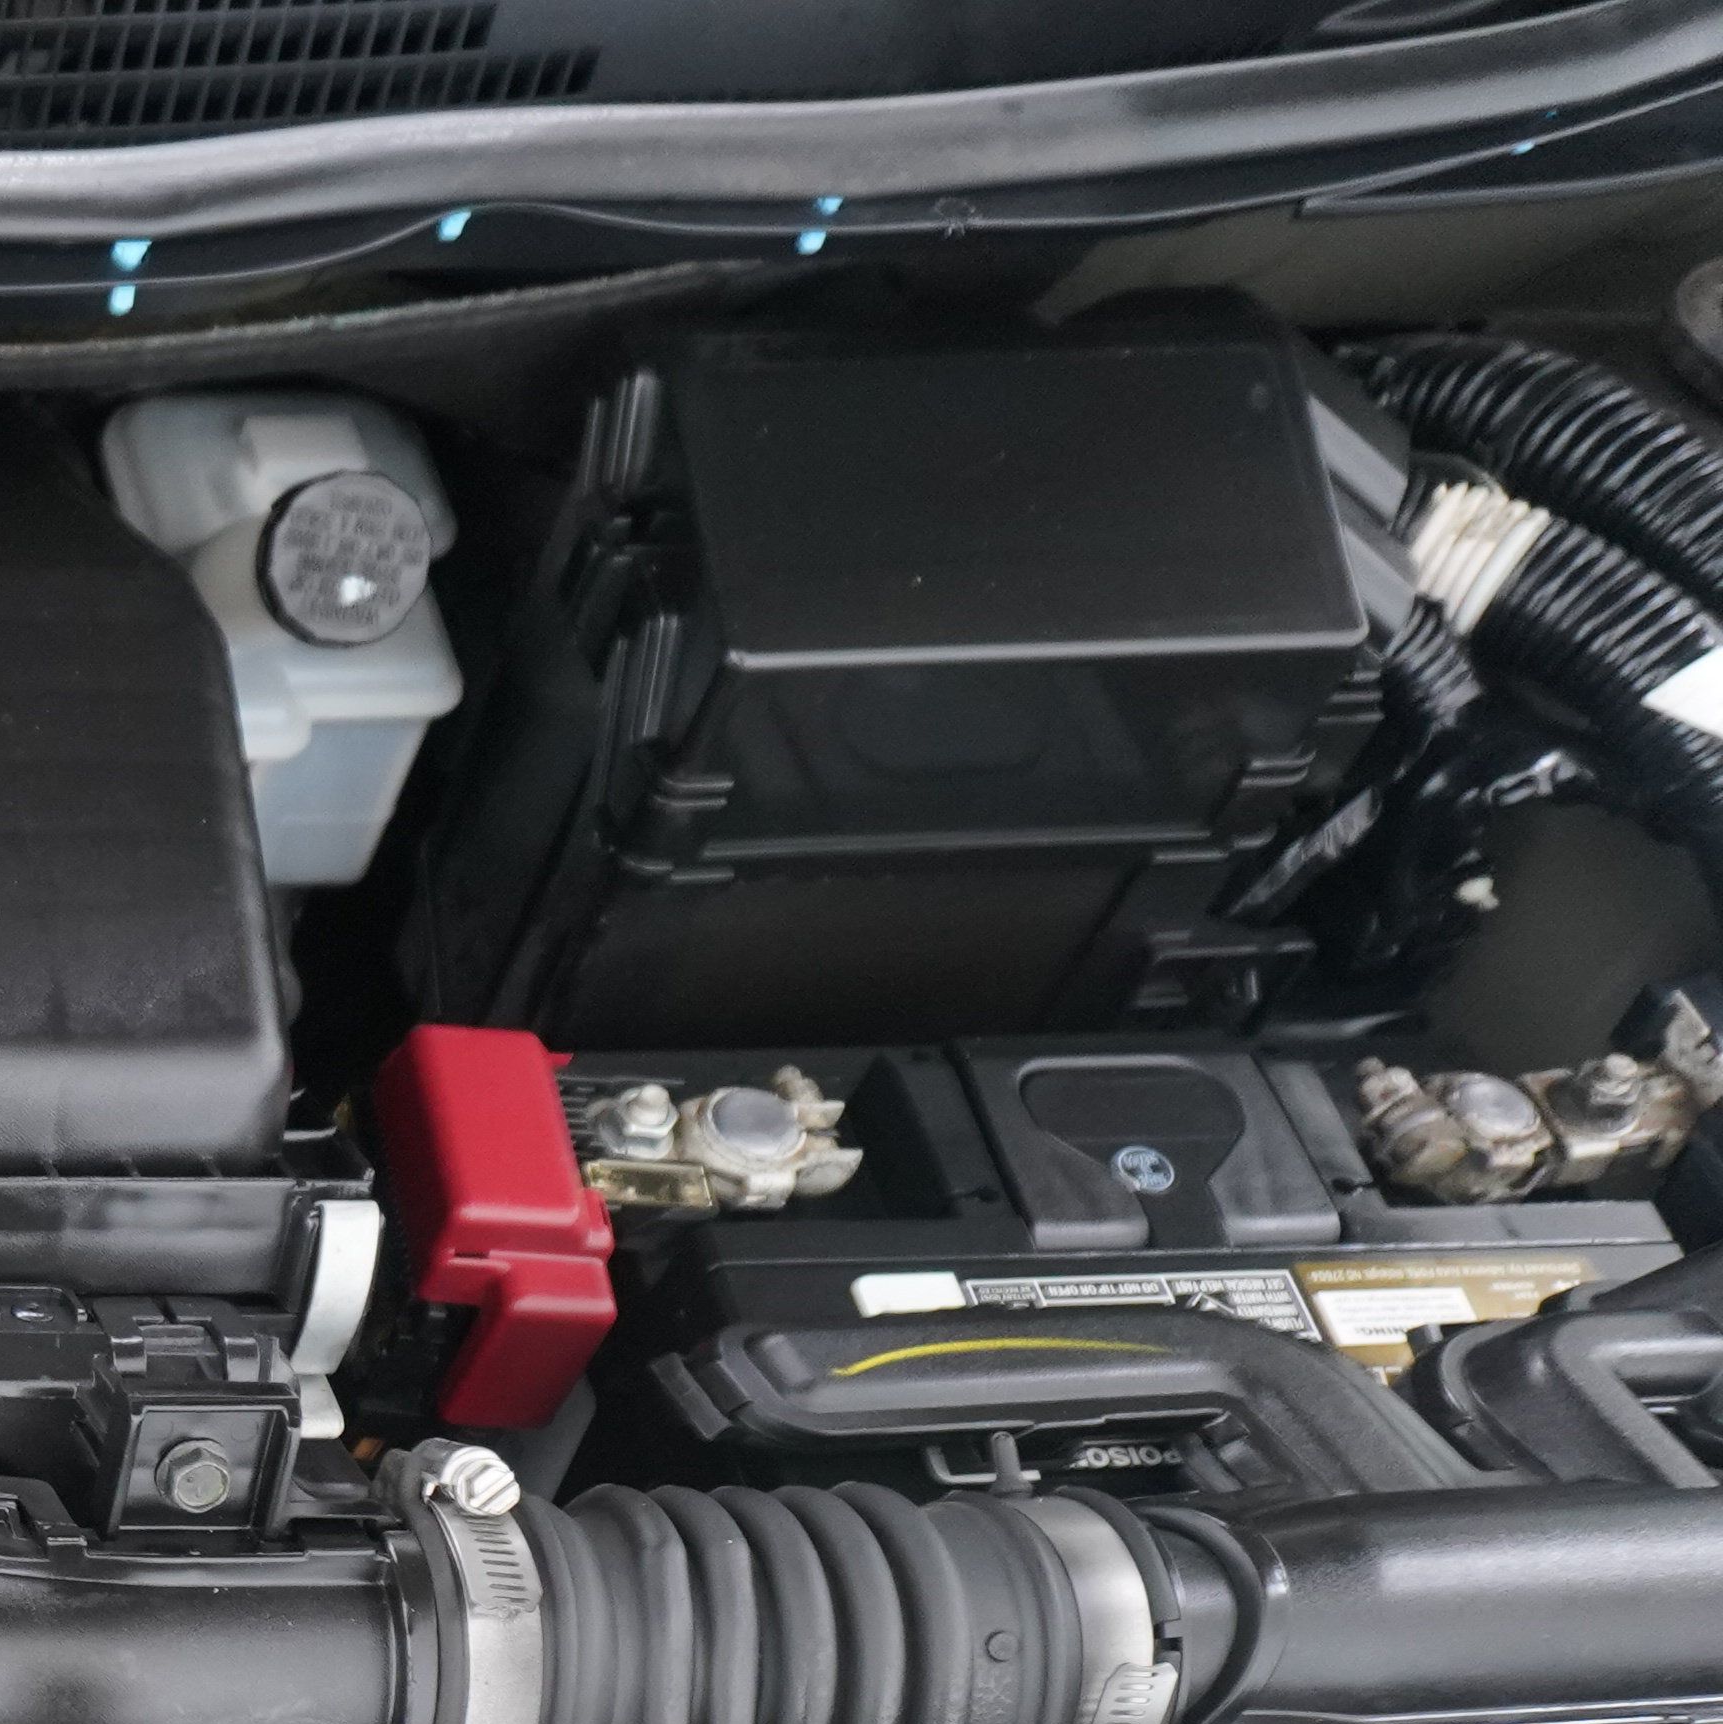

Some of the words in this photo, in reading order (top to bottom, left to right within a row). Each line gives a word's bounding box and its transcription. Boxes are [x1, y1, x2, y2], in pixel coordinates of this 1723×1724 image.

[1080, 1284, 1098, 1295] OR
[1099, 1283, 1117, 1294] TIP
[1118, 1282, 1141, 1294] NOT
[1142, 1282, 1160, 1293] DO
